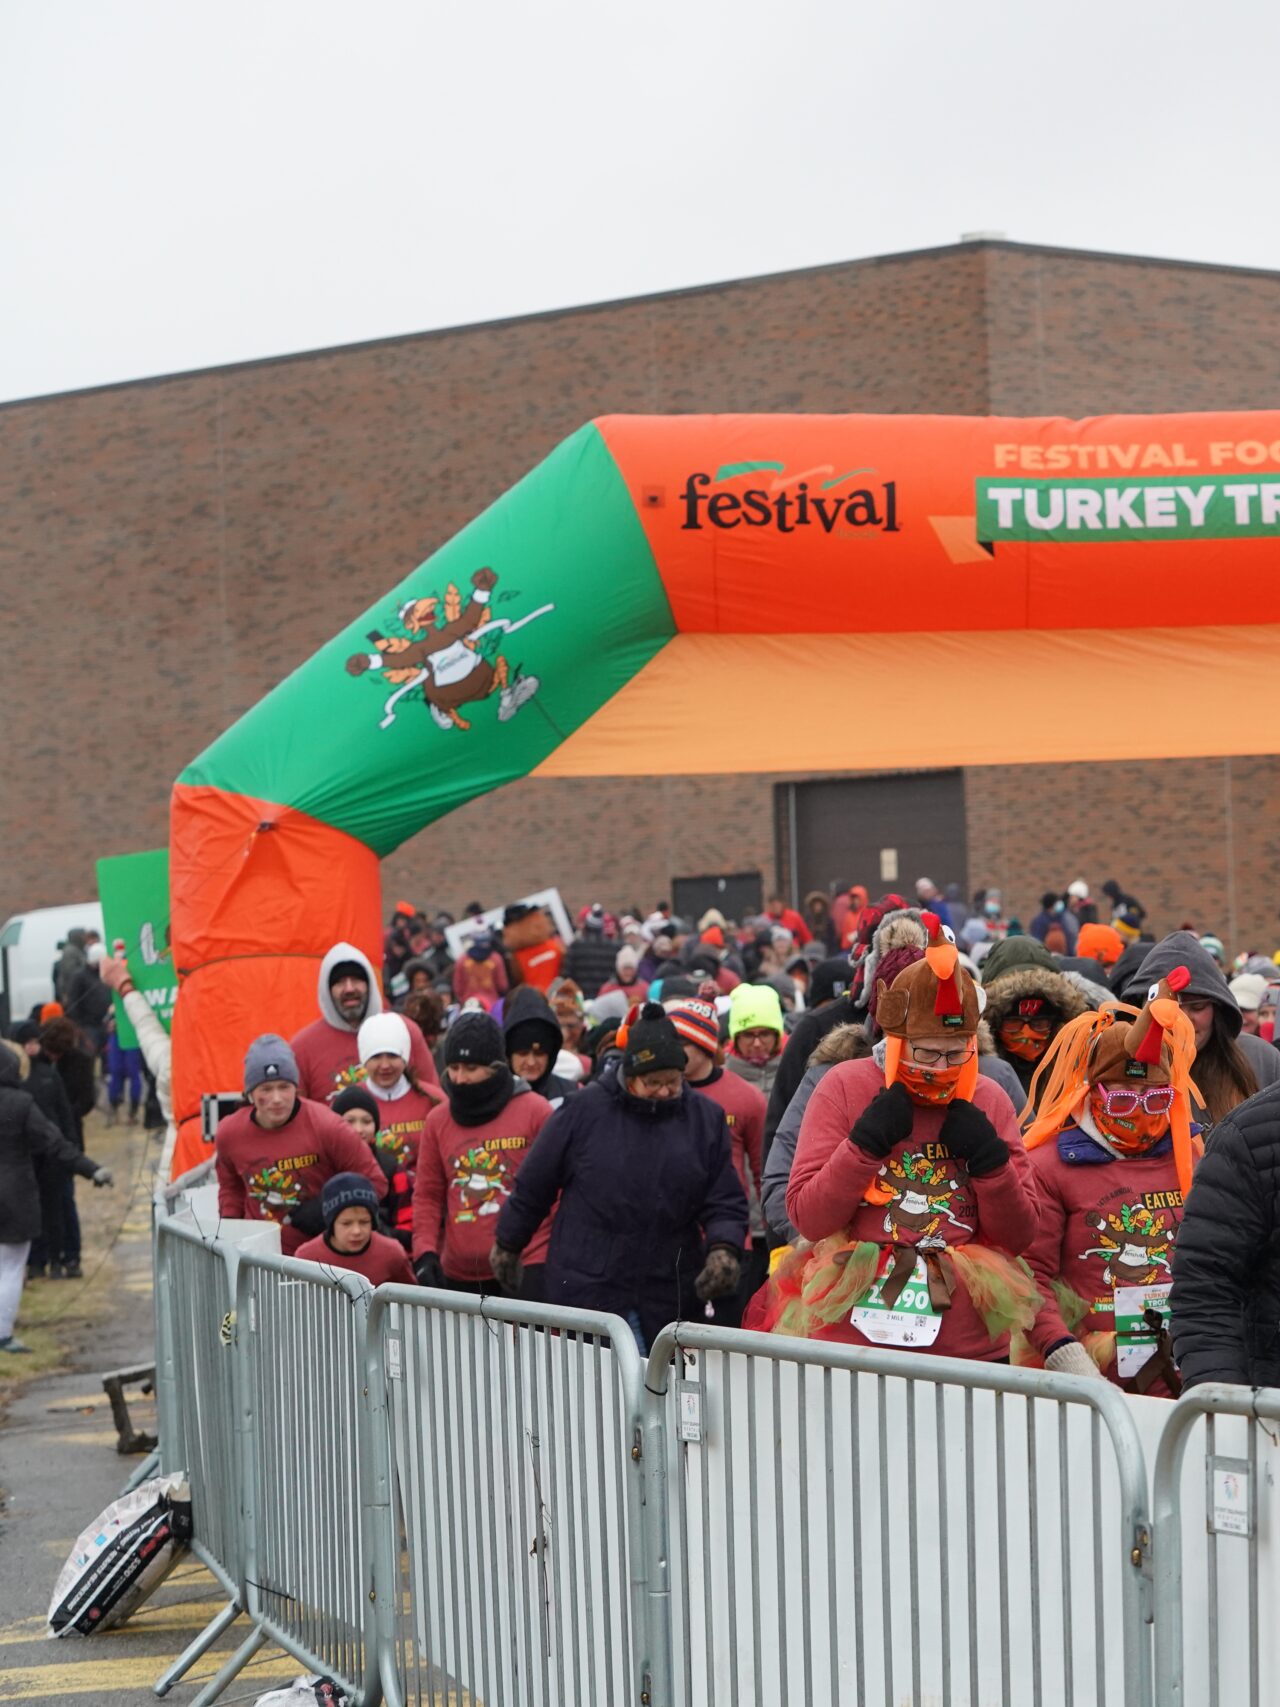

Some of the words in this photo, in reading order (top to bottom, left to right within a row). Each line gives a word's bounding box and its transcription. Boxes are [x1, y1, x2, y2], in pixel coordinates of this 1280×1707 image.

[993, 443, 1198, 470] FESTIVAL
[679, 472, 901, 533] festival
[987, 485, 1215, 529] TURKEY
[391, 1122, 405, 1134] EAT
[1117, 1119, 1132, 1129] TROT
[484, 1139, 500, 1151] EAT
[501, 1137, 526, 1149] BEEF!
[278, 1158, 293, 1171] EAT
[293, 1154, 318, 1169] BEEF!
[1145, 1193, 1166, 1210] EAT
[1148, 1299, 1166, 1308] TROT
